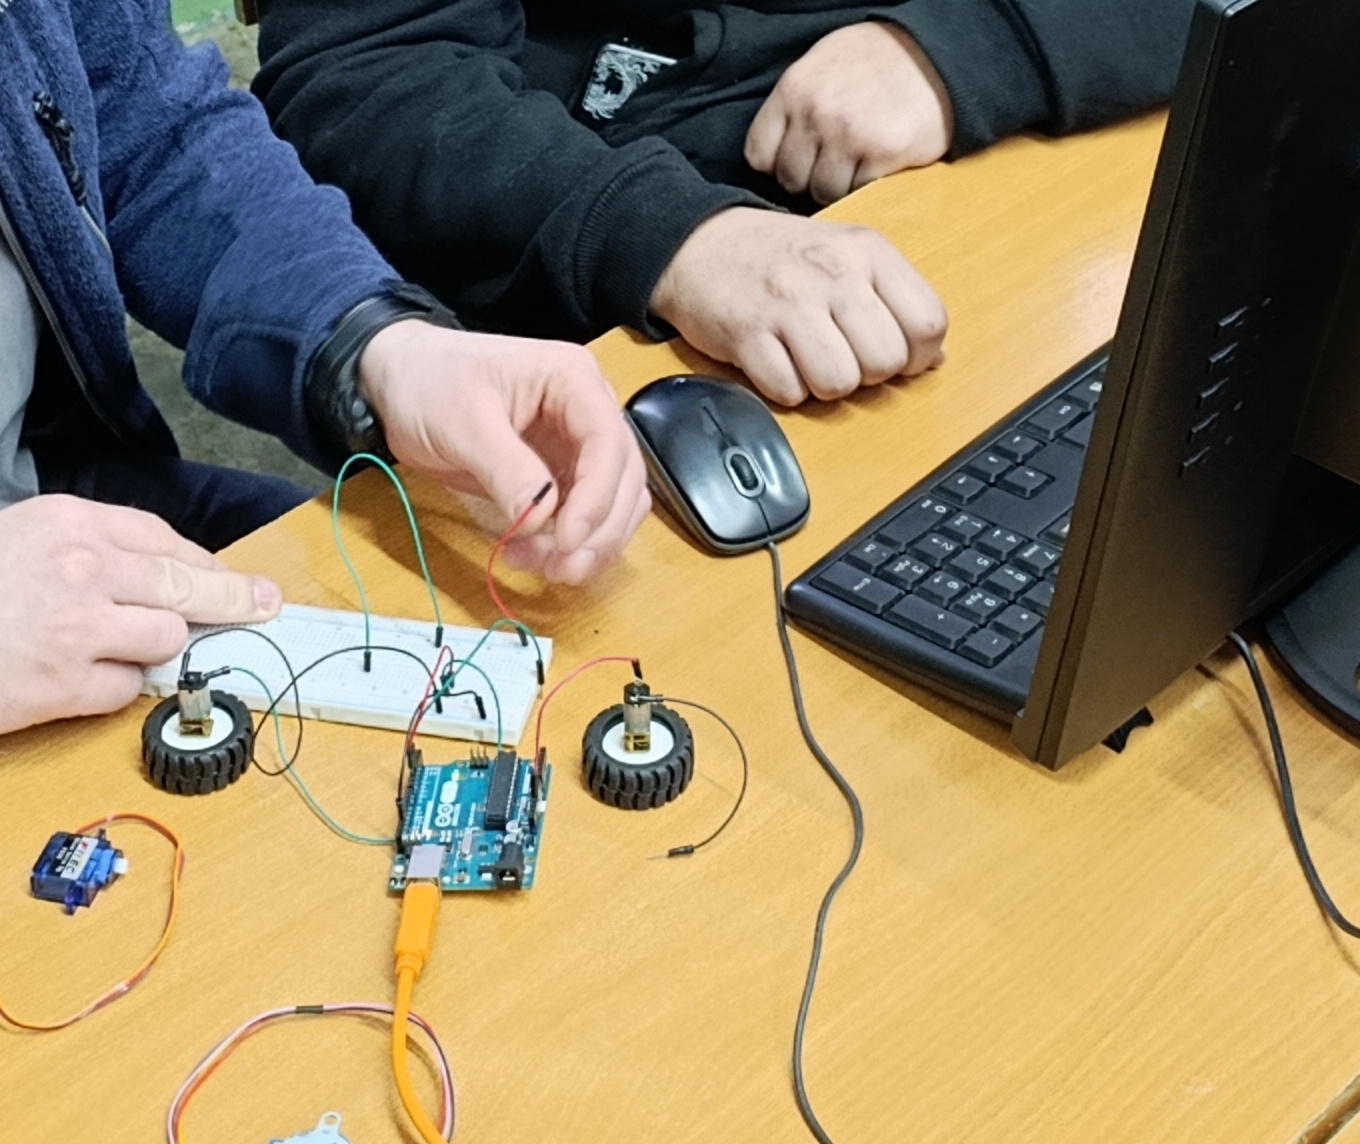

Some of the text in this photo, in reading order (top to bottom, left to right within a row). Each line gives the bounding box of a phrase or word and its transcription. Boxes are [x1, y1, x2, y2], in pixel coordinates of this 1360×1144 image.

[934, 505, 947, 513] 0
[1006, 535, 1016, 543] 4
[941, 542, 953, 551] 2
[1043, 551, 1056, 561] 7
[976, 557, 989, 567] 5
[912, 565, 924, 574] 3
[1014, 573, 1027, 582] 8
[947, 581, 959, 590] 6
[983, 598, 997, 607] 9
